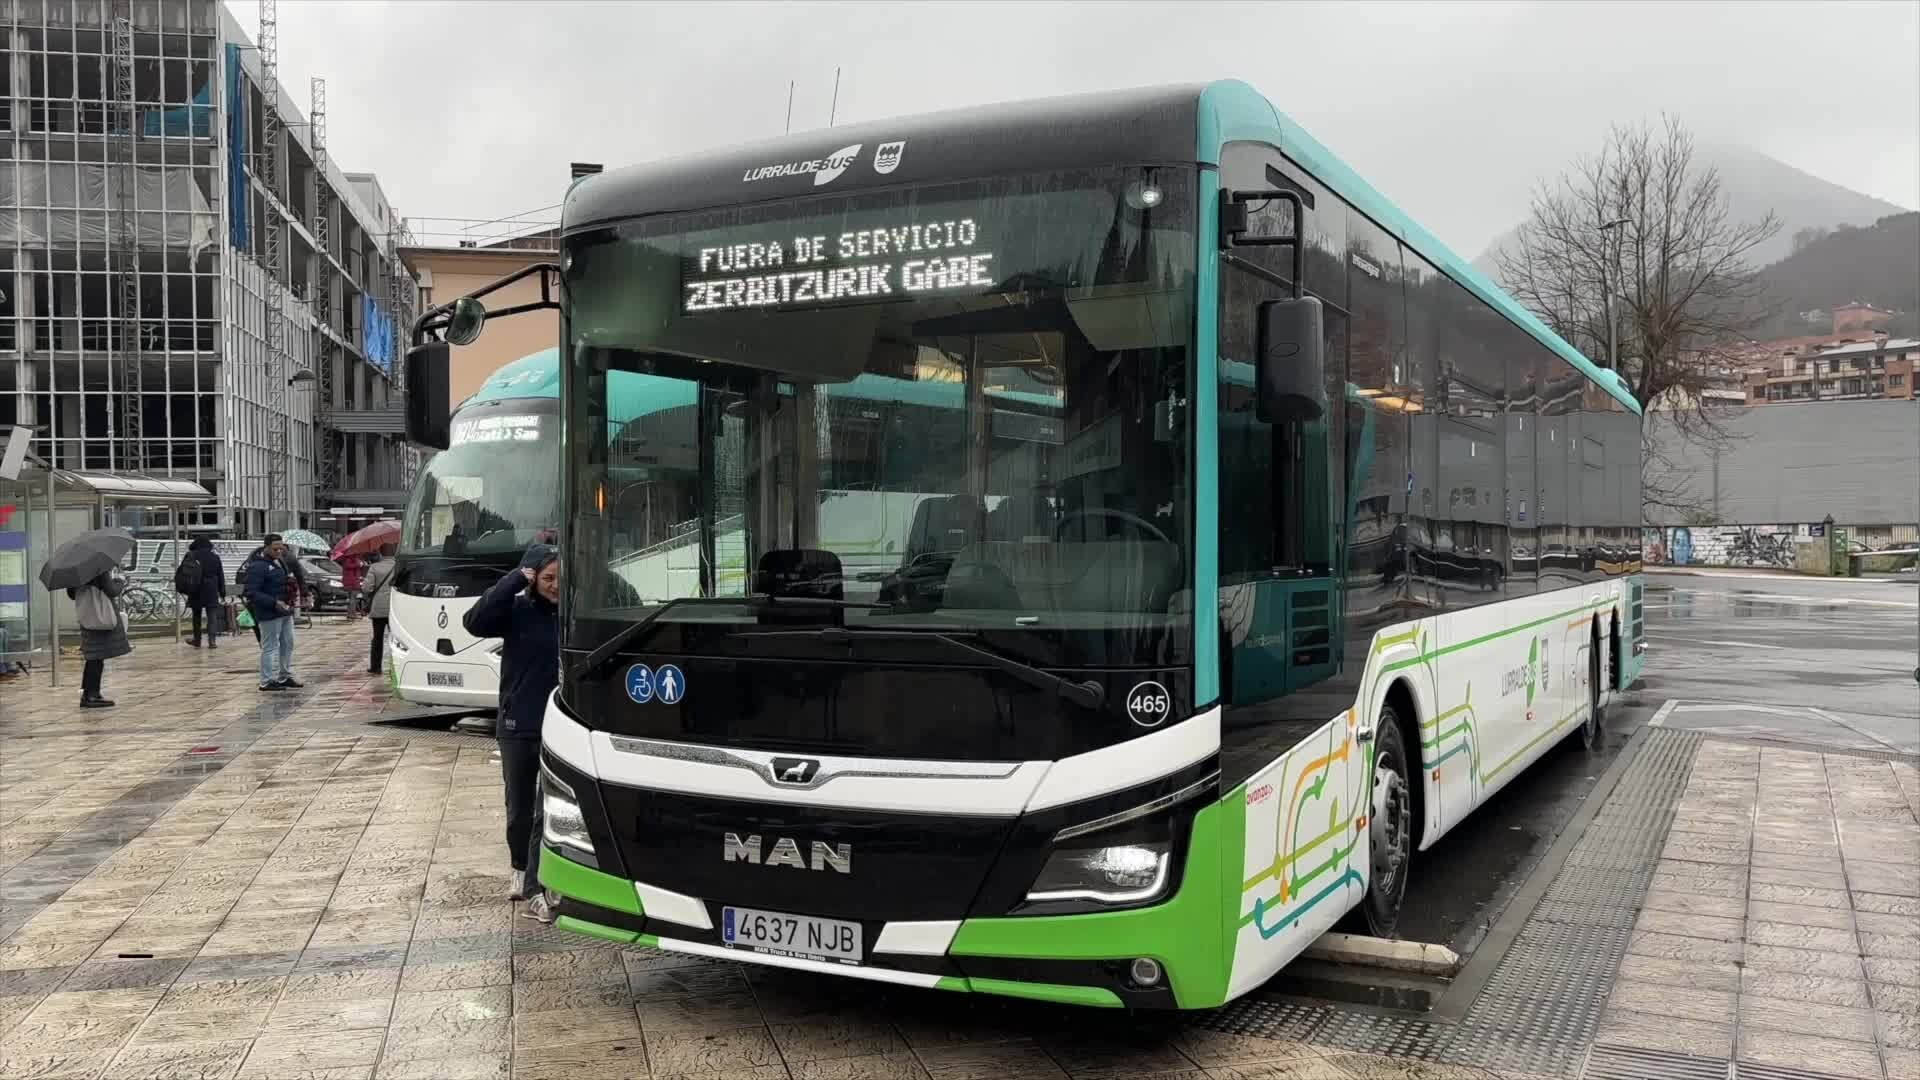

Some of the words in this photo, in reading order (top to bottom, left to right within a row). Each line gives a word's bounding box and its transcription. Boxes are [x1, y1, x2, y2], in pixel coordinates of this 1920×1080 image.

[743, 155, 854, 182] LURRALDEBUS
[701, 241, 783, 272] FUERA
[795, 236, 826, 263] DE
[839, 219, 977, 258] SERVICIO
[686, 264, 892, 311] ZERBITZURIK
[902, 253, 994, 291] GABE
[1130, 695, 1166, 713] 465
[724, 832, 851, 873] MAN
[740, 913, 798, 946] 4637
[807, 921, 854, 953] NJB
